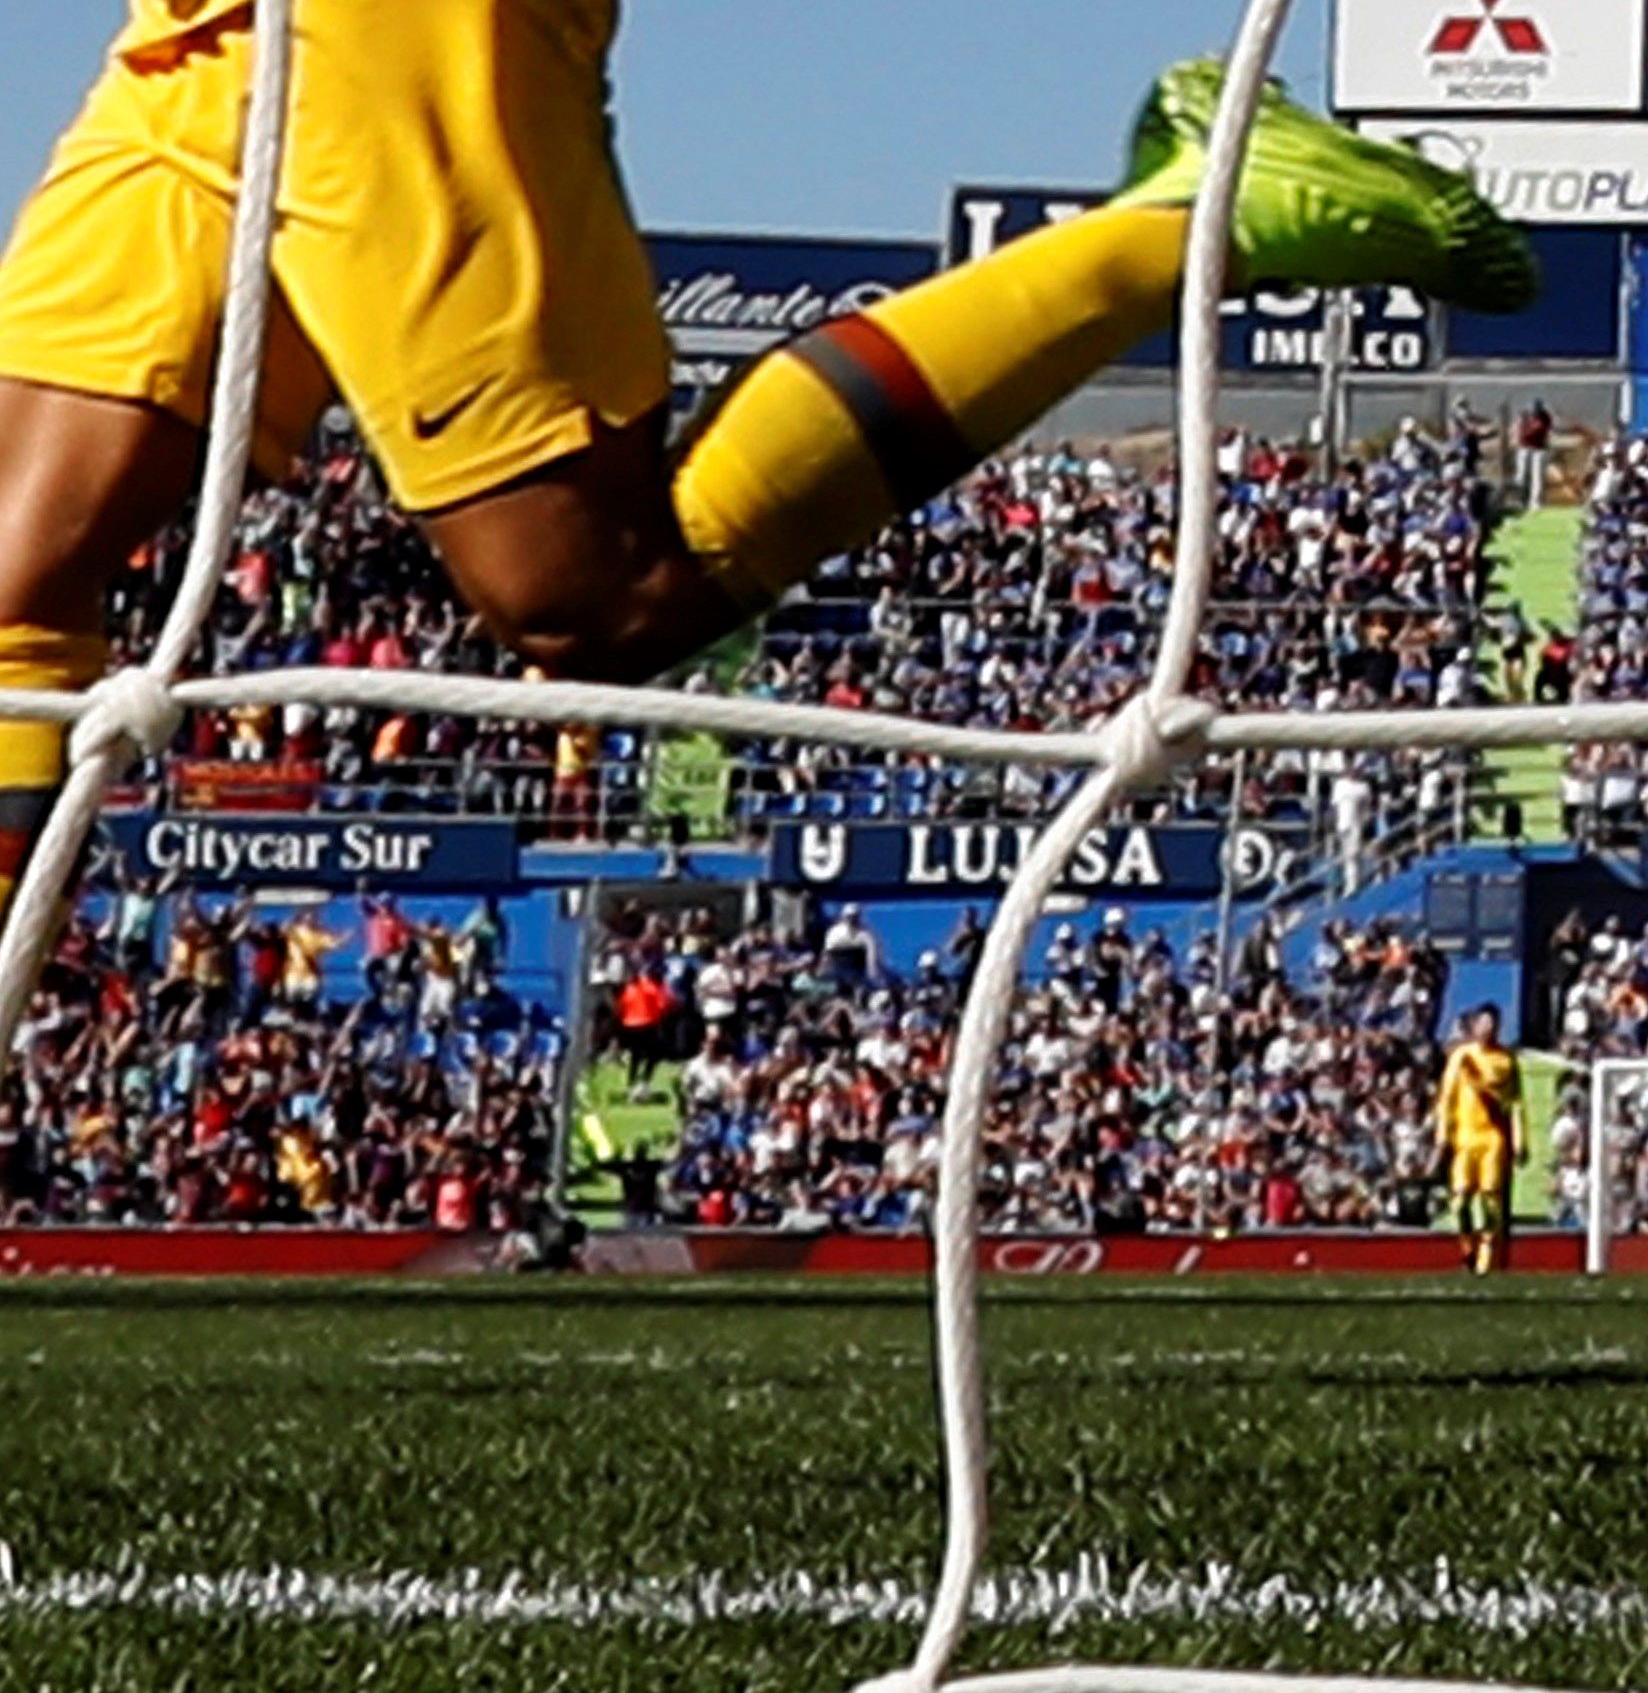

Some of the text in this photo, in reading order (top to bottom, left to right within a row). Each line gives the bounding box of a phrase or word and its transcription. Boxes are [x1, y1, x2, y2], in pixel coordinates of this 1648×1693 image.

[1254, 329, 1422, 366] IMCO
[146, 820, 432, 880] Citycar Sur
[907, 823, 1161, 885] LUJSA
